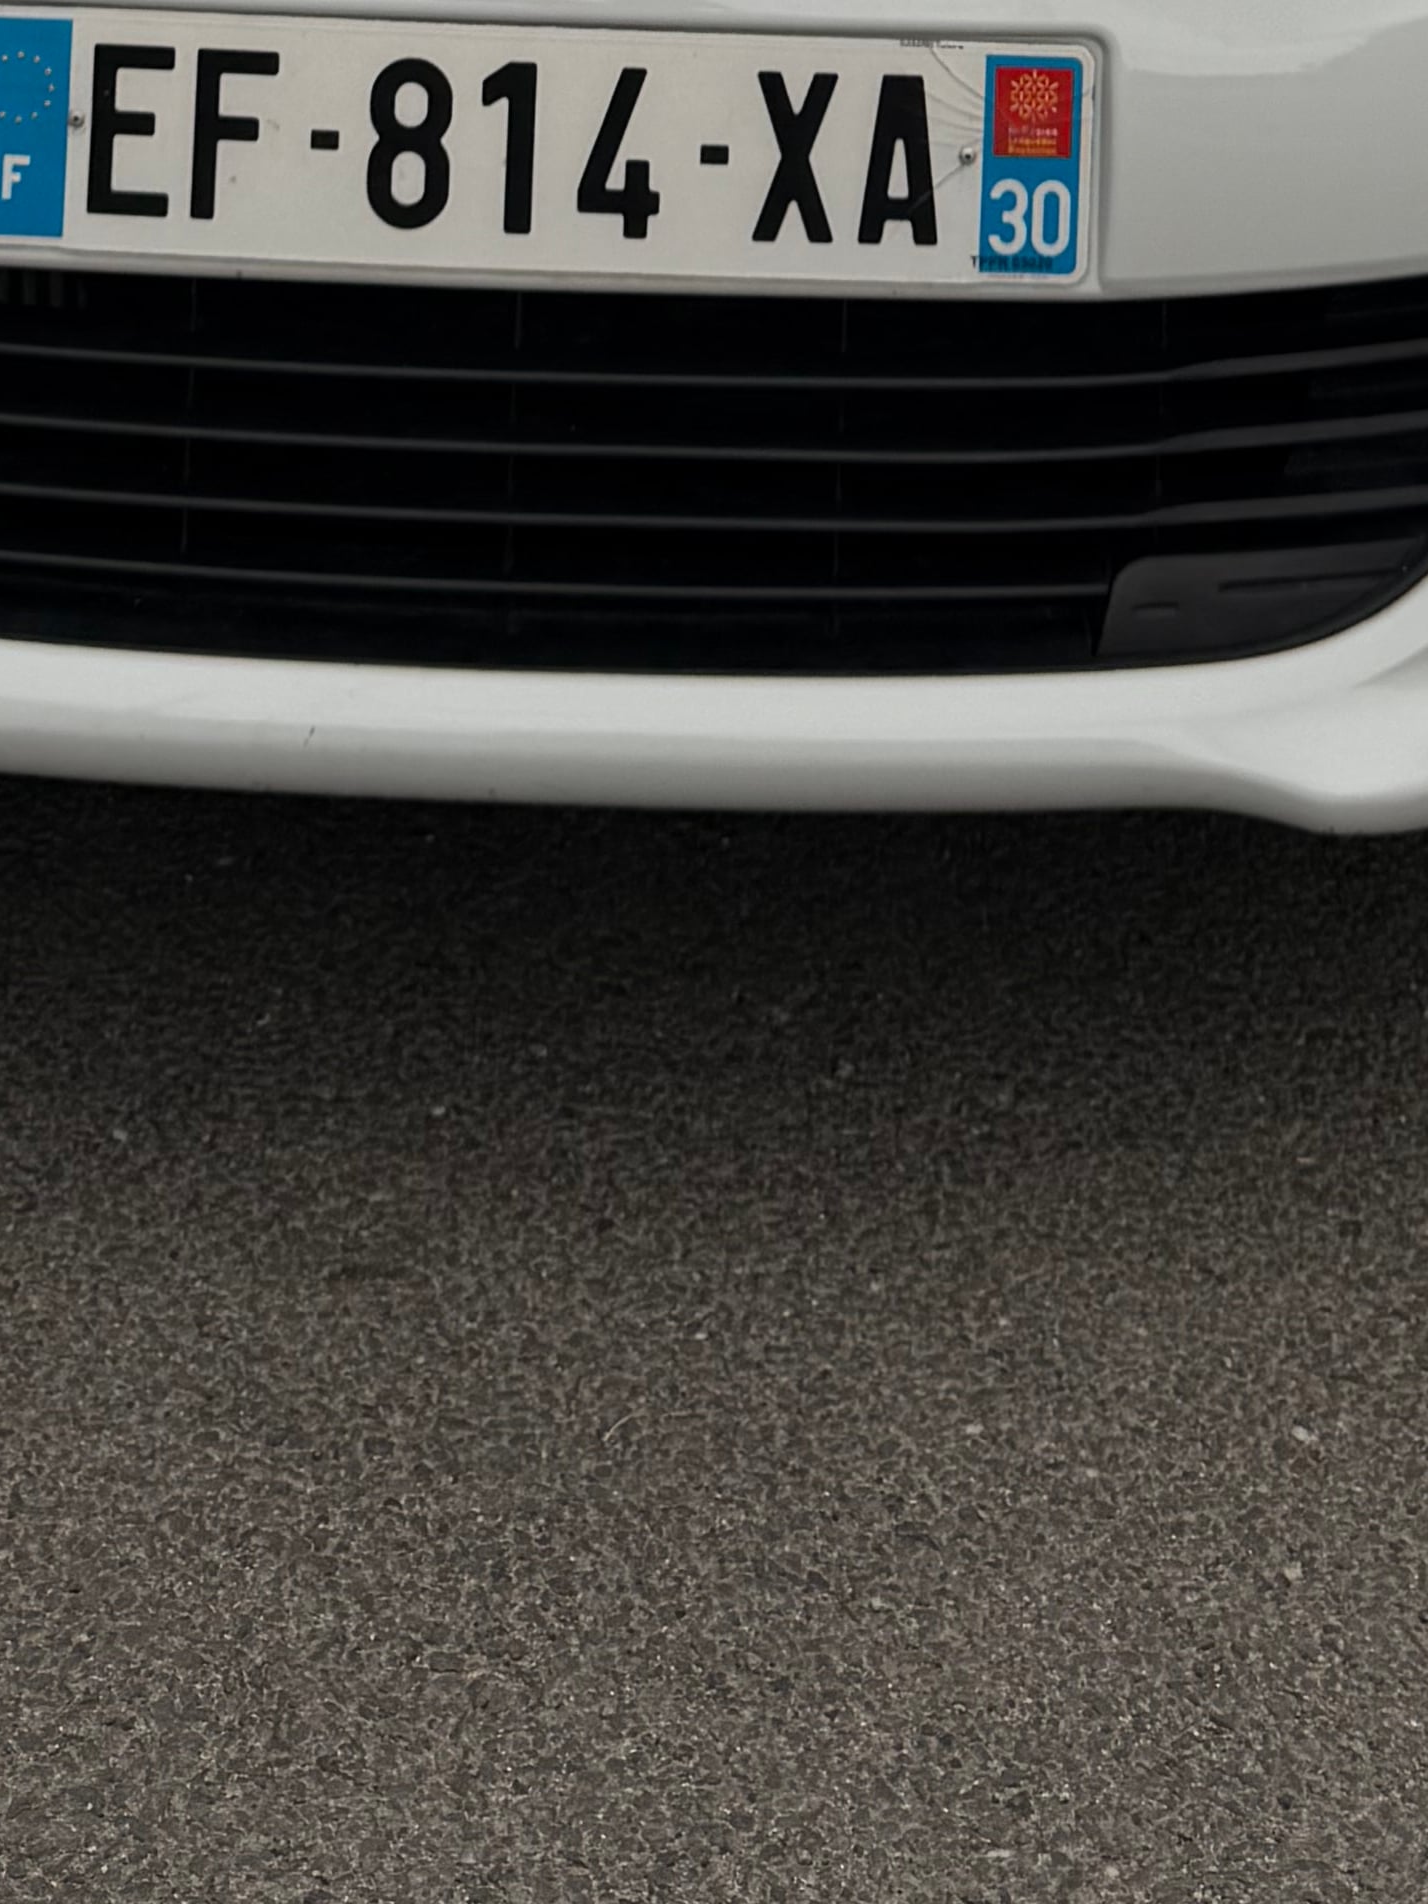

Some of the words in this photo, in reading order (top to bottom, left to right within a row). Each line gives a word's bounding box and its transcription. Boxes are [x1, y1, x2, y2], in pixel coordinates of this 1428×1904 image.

[1, 153, 31, 201] F
[87, 44, 938, 246] EF-814-XA
[988, 178, 1072, 257] 30
